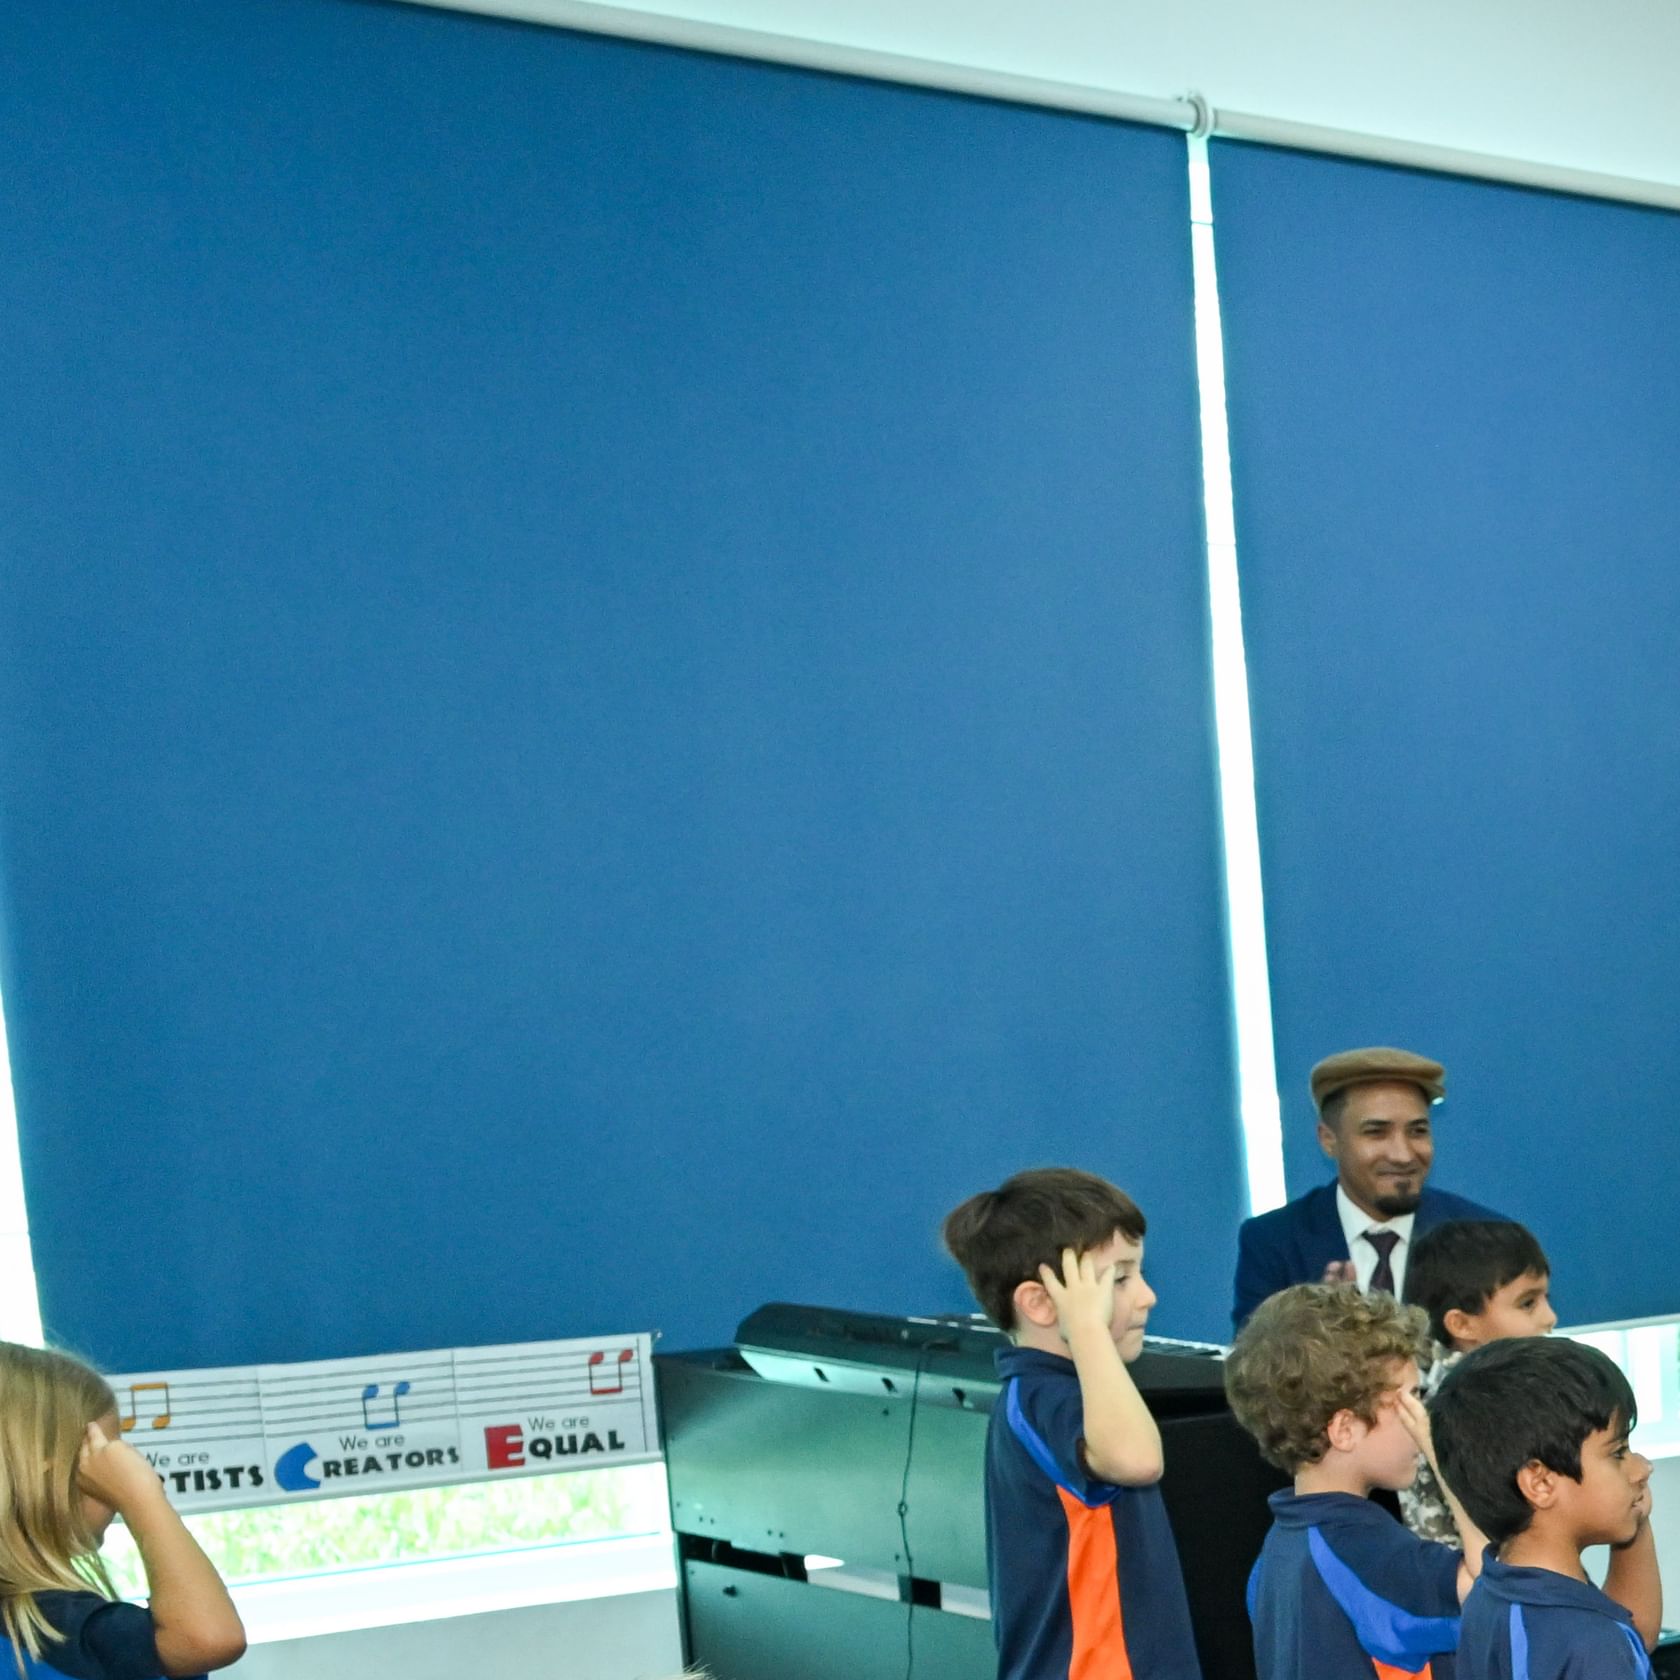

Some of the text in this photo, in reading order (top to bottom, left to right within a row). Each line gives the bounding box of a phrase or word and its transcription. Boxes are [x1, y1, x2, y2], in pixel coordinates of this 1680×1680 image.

[527, 1416, 590, 1432] We are
[338, 1433, 405, 1451] We are
[484, 1423, 625, 1470] EQUAL
[145, 1451, 210, 1467] We are
[274, 1441, 460, 1493] CREATORS
[159, 1465, 264, 1493] TISTS
